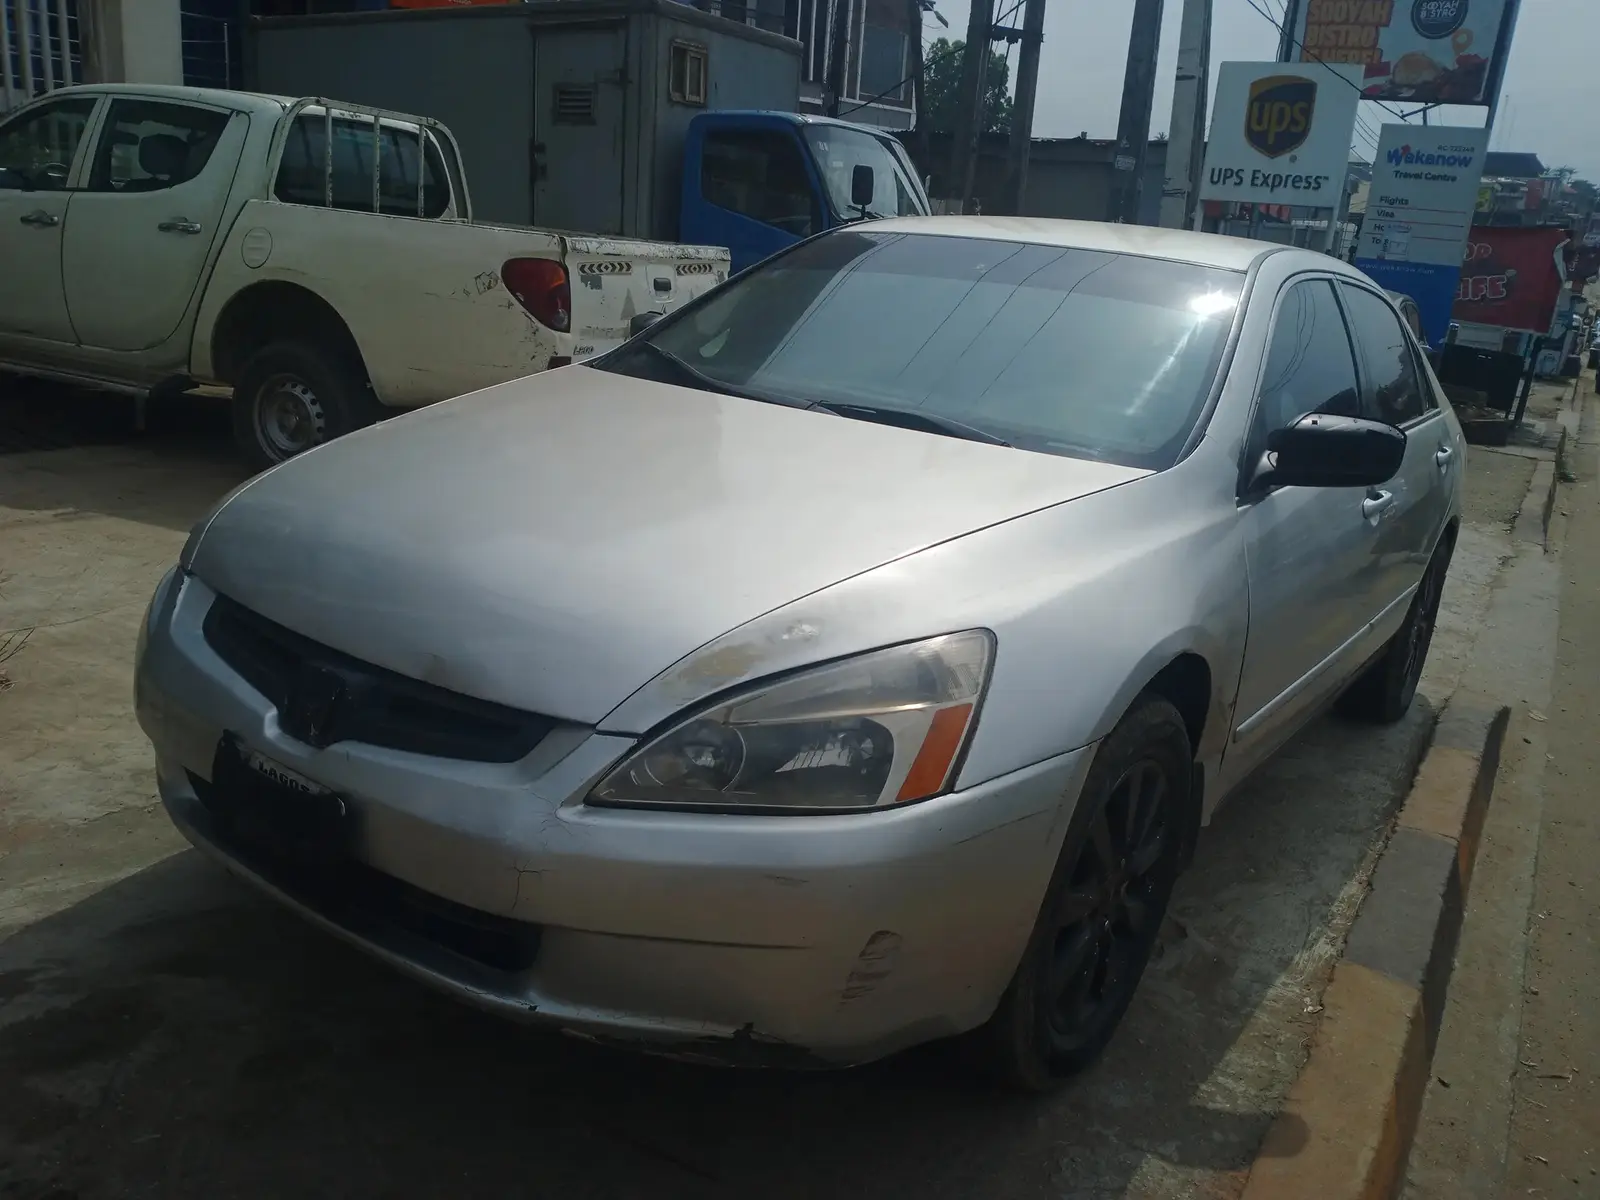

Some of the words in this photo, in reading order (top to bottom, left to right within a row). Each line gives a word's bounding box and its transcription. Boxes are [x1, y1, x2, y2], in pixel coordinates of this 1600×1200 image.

[1308, 0, 1389, 23] SOOYAH
[1420, 9, 1457, 18] BISTRO
[1304, 24, 1376, 48] BISTRO
[1251, 101, 1309, 145] ups
[1387, 145, 1473, 168] Wakanow
[1210, 167, 1244, 186] UPS
[1393, 170, 1423, 180] Travel
[1424, 172, 1458, 182] Centre
[1379, 195, 1410, 206] Flights
[1376, 209, 1396, 218] Visa
